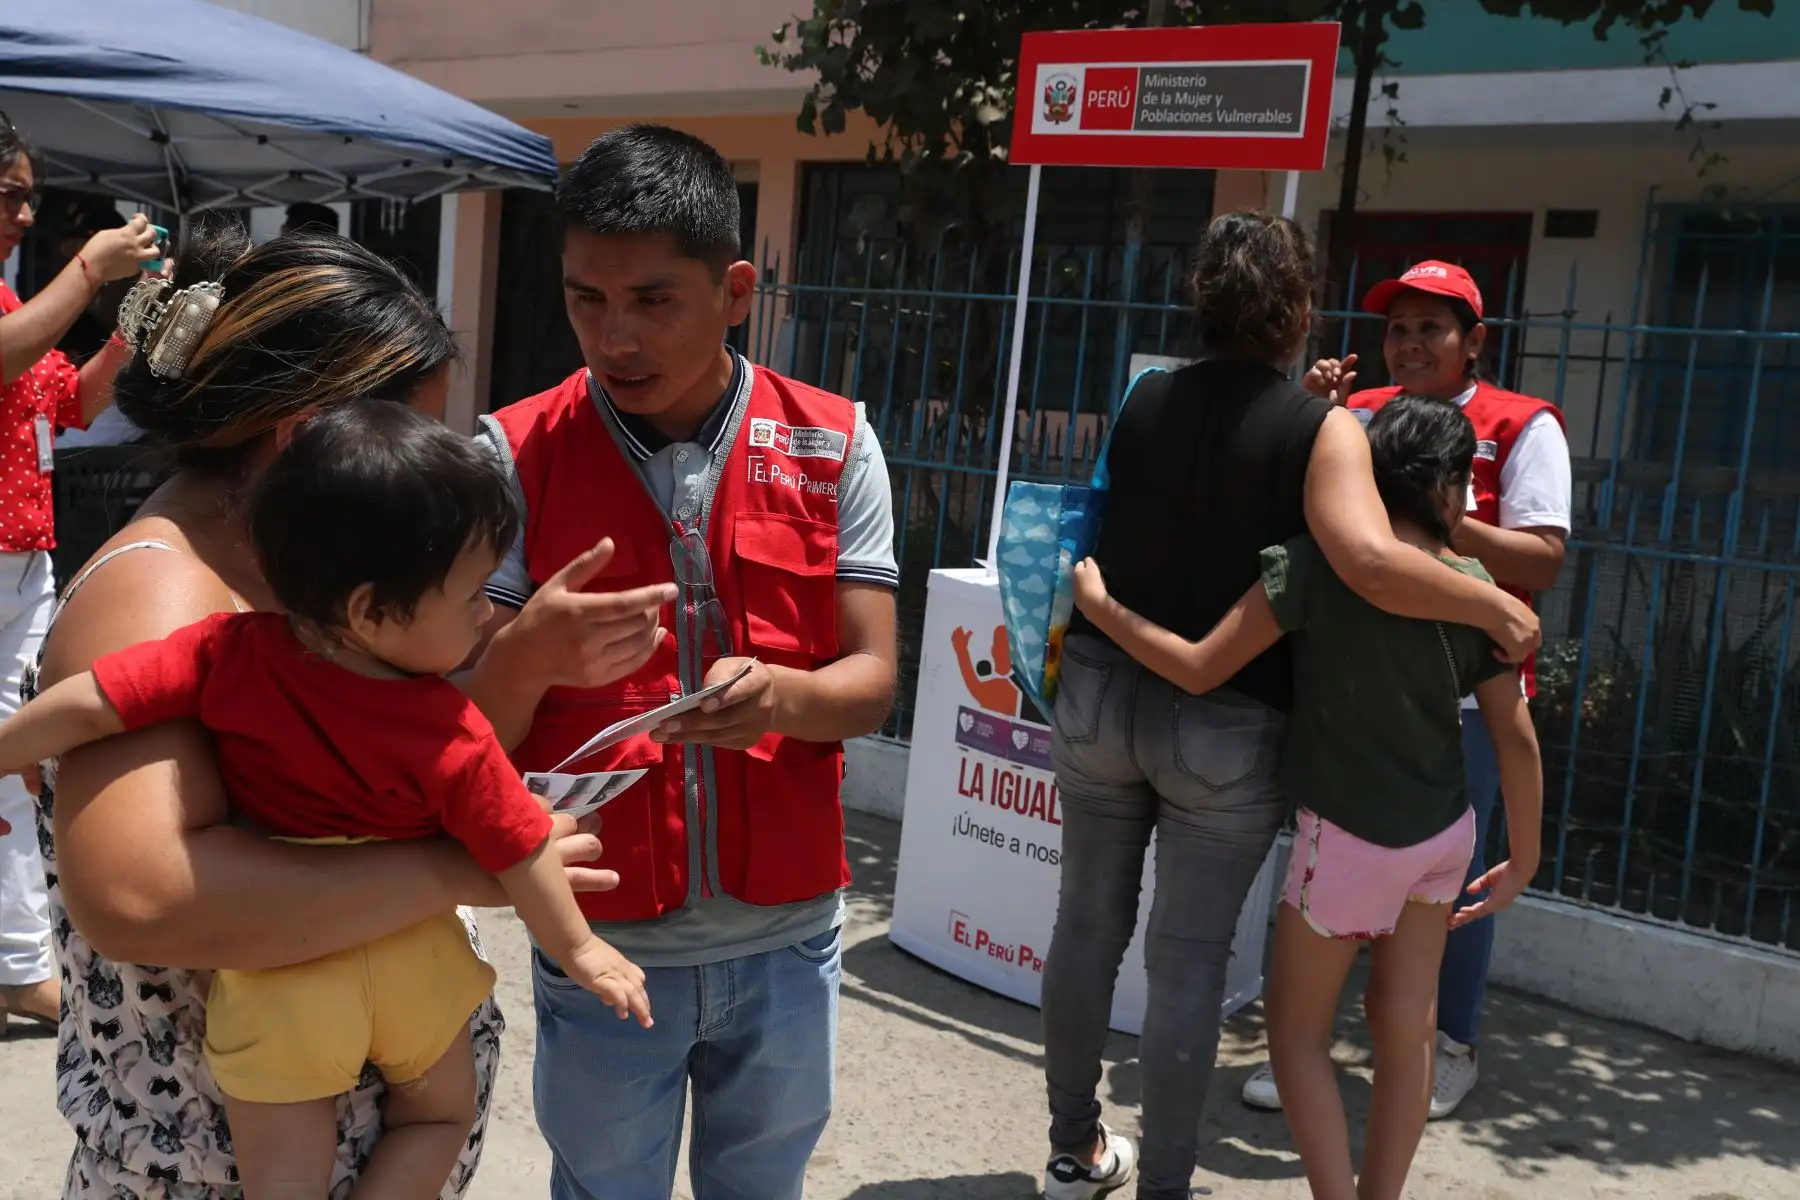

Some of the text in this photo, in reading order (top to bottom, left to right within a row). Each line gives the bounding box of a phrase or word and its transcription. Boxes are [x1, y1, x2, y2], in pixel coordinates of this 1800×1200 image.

[1144, 73, 1207, 88] Ministerio
[1087, 85, 1131, 109] PERÚ
[1142, 91, 1224, 108] de la Mujer y
[1140, 108, 1293, 124] Poblaciones Vulnerables
[775, 432, 789, 445] PERÚ
[958, 756, 1062, 826] LA IGUAL
[952, 811, 1063, 866] ¡Únete a nos
